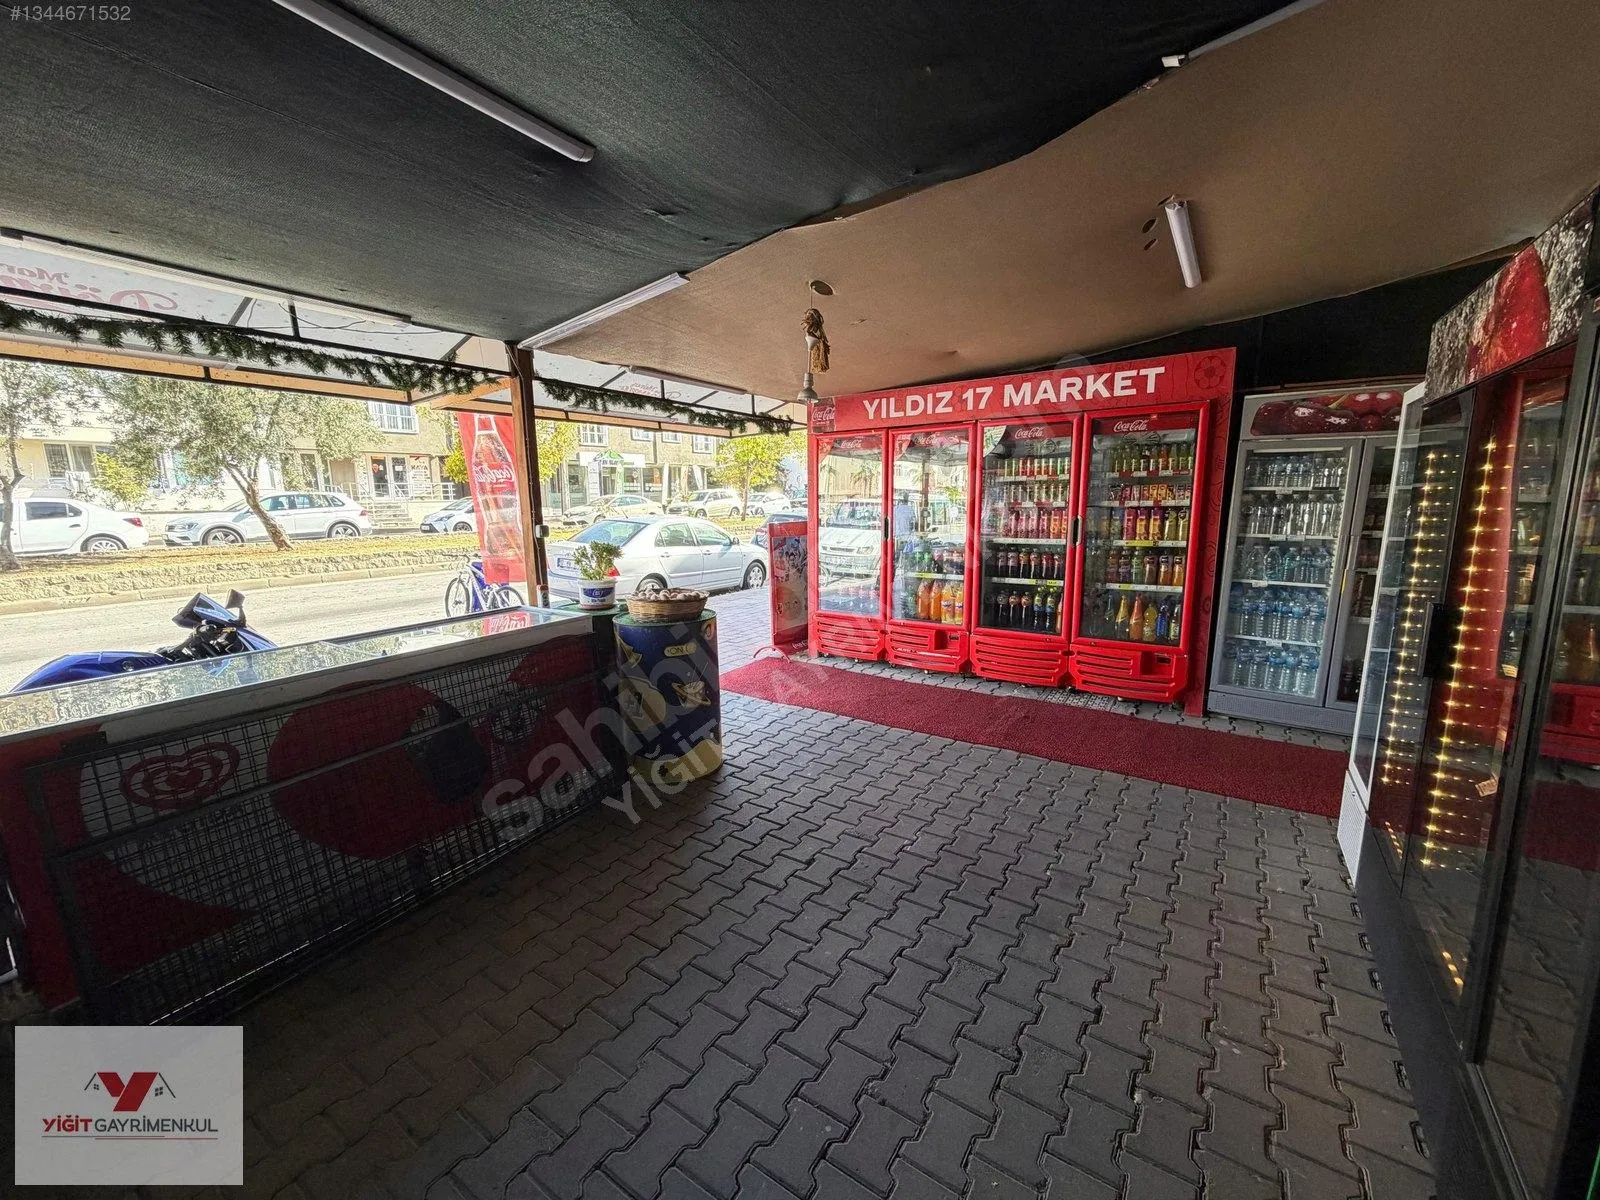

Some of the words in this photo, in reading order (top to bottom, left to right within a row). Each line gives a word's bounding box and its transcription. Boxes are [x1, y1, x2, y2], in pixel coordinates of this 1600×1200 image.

[862, 391, 953, 420] YILDIZ
[961, 386, 994, 411] 17
[1003, 366, 1165, 407] MARKET
[1113, 419, 1149, 432] Coca-Cola
[1014, 426, 1045, 440] Coca-Cola
